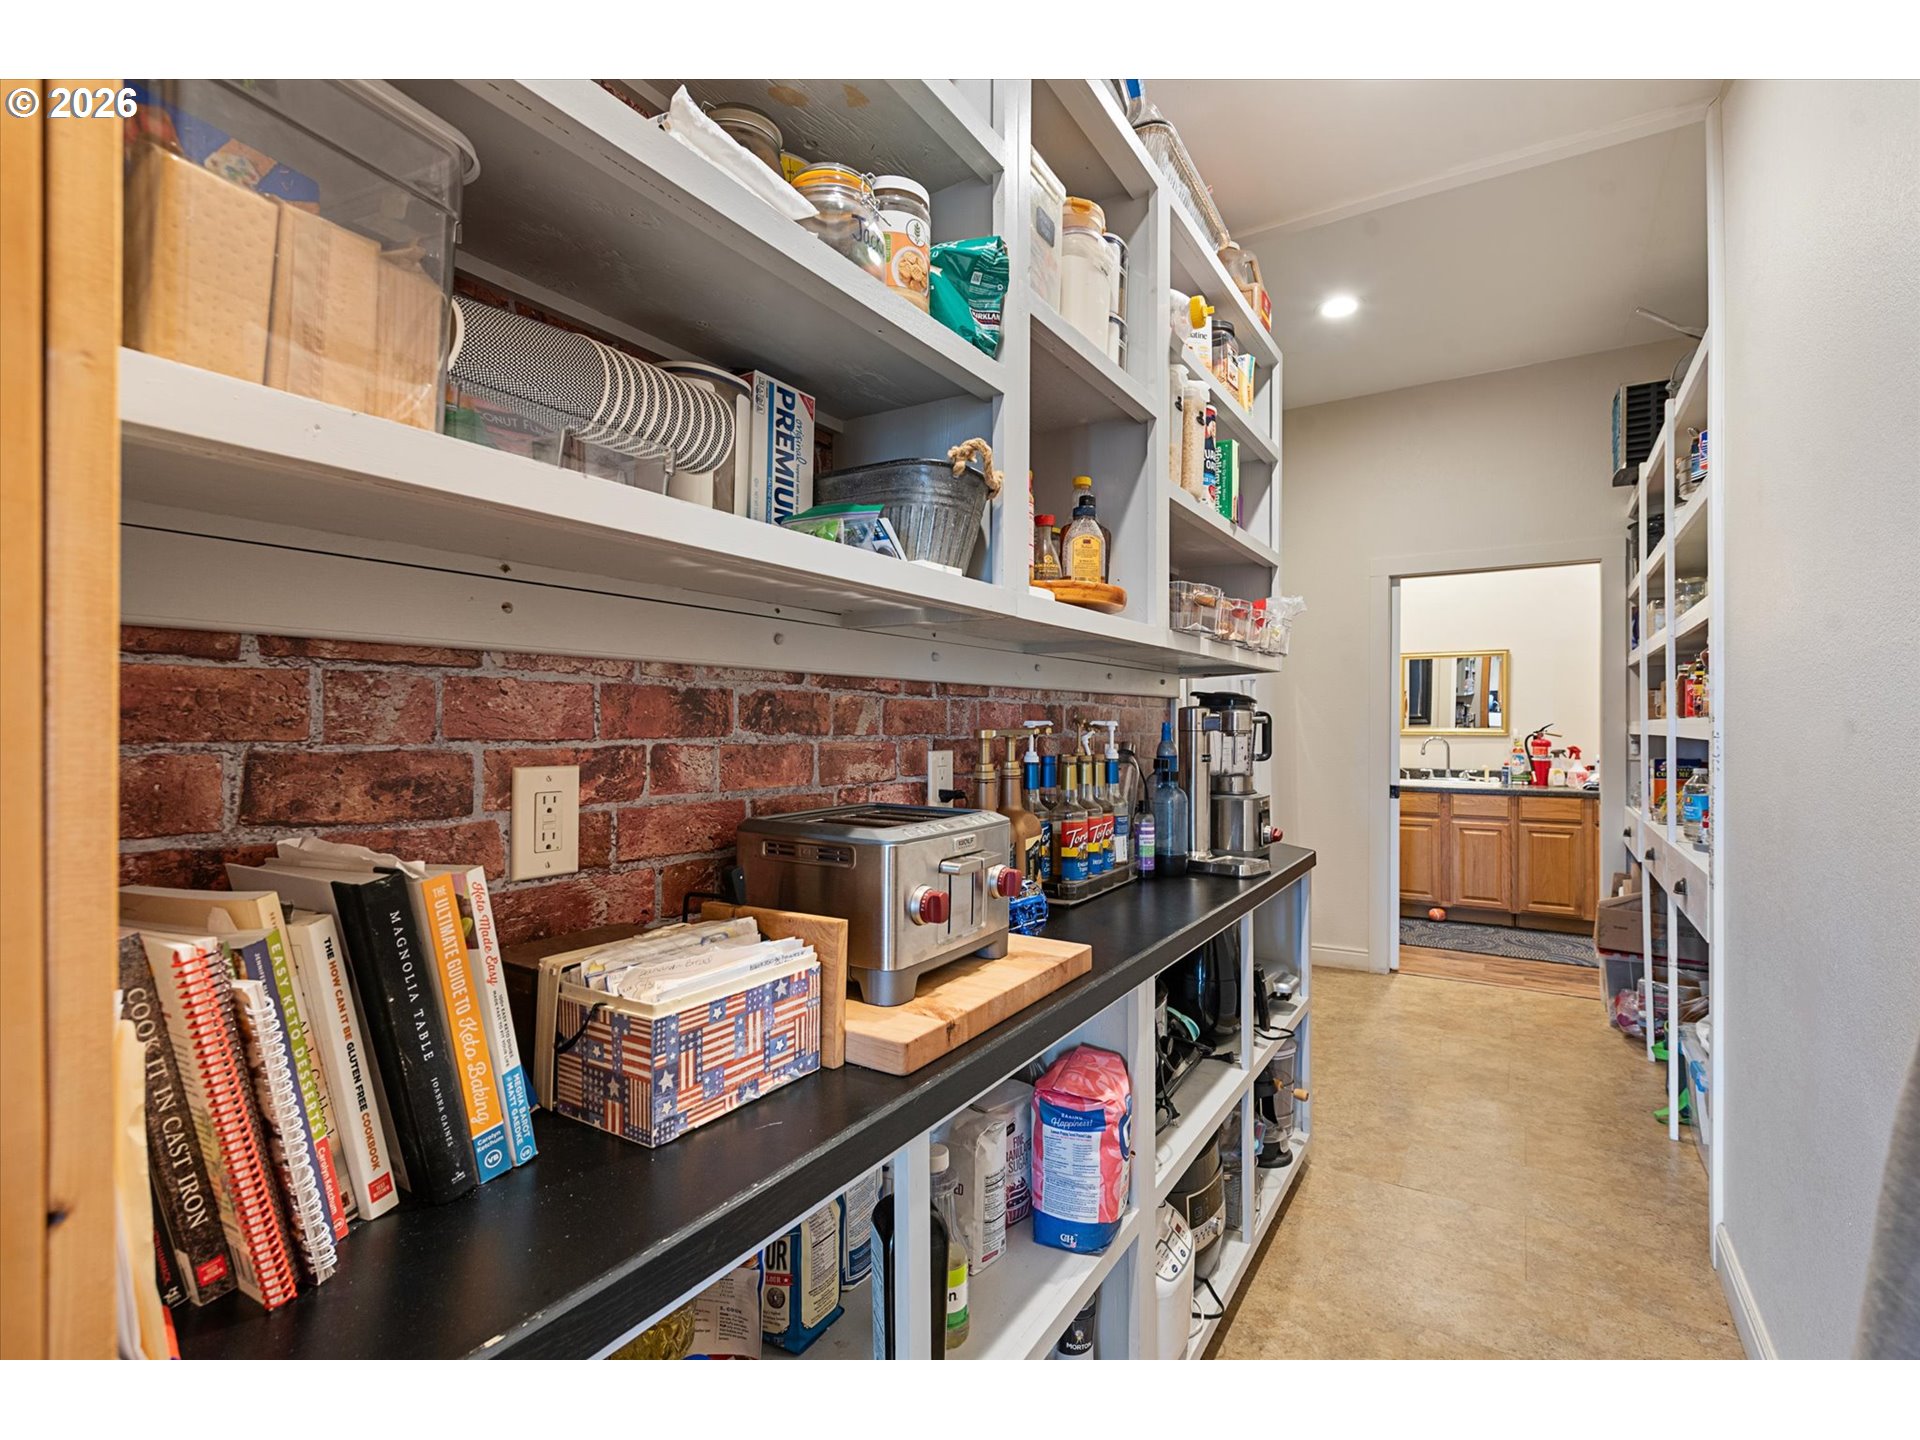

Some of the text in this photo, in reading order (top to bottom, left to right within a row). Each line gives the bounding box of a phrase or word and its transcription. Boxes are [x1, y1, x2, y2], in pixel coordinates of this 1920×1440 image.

[796, 418, 808, 465] original
[323, 936, 335, 959] THE
[471, 881, 499, 987] Keto Made Easy
[328, 960, 341, 987] HOW
[389, 910, 435, 1061] MAGNOLIA TABLE
[334, 988, 346, 1015] CAN
[432, 884, 491, 1125] THE ULTIMATE GUIDE TO Keto Baking
[340, 1015, 349, 1027] IT
[343, 1026, 353, 1041] BE
[271, 943, 325, 1140] EASY KETO DESSERTS
[346, 1041, 362, 1085] GLUTEN
[126, 987, 208, 1229] COOK IT IN CAST IRON
[354, 1084, 368, 1113] FREE
[506, 1081, 517, 1107] MATT
[513, 1073, 531, 1138] MEGHA BAROT
[361, 1112, 381, 1170] COOKBOOK
[440, 1115, 454, 1148] GAINES
[476, 1135, 505, 1153] Ketchum
[477, 1130, 502, 1146] Carolyn
[511, 1108, 524, 1146] GAEDKE
[316, 1146, 338, 1216] Carolyn Ketchum
[1066, 1341, 1092, 1351] MORTON
